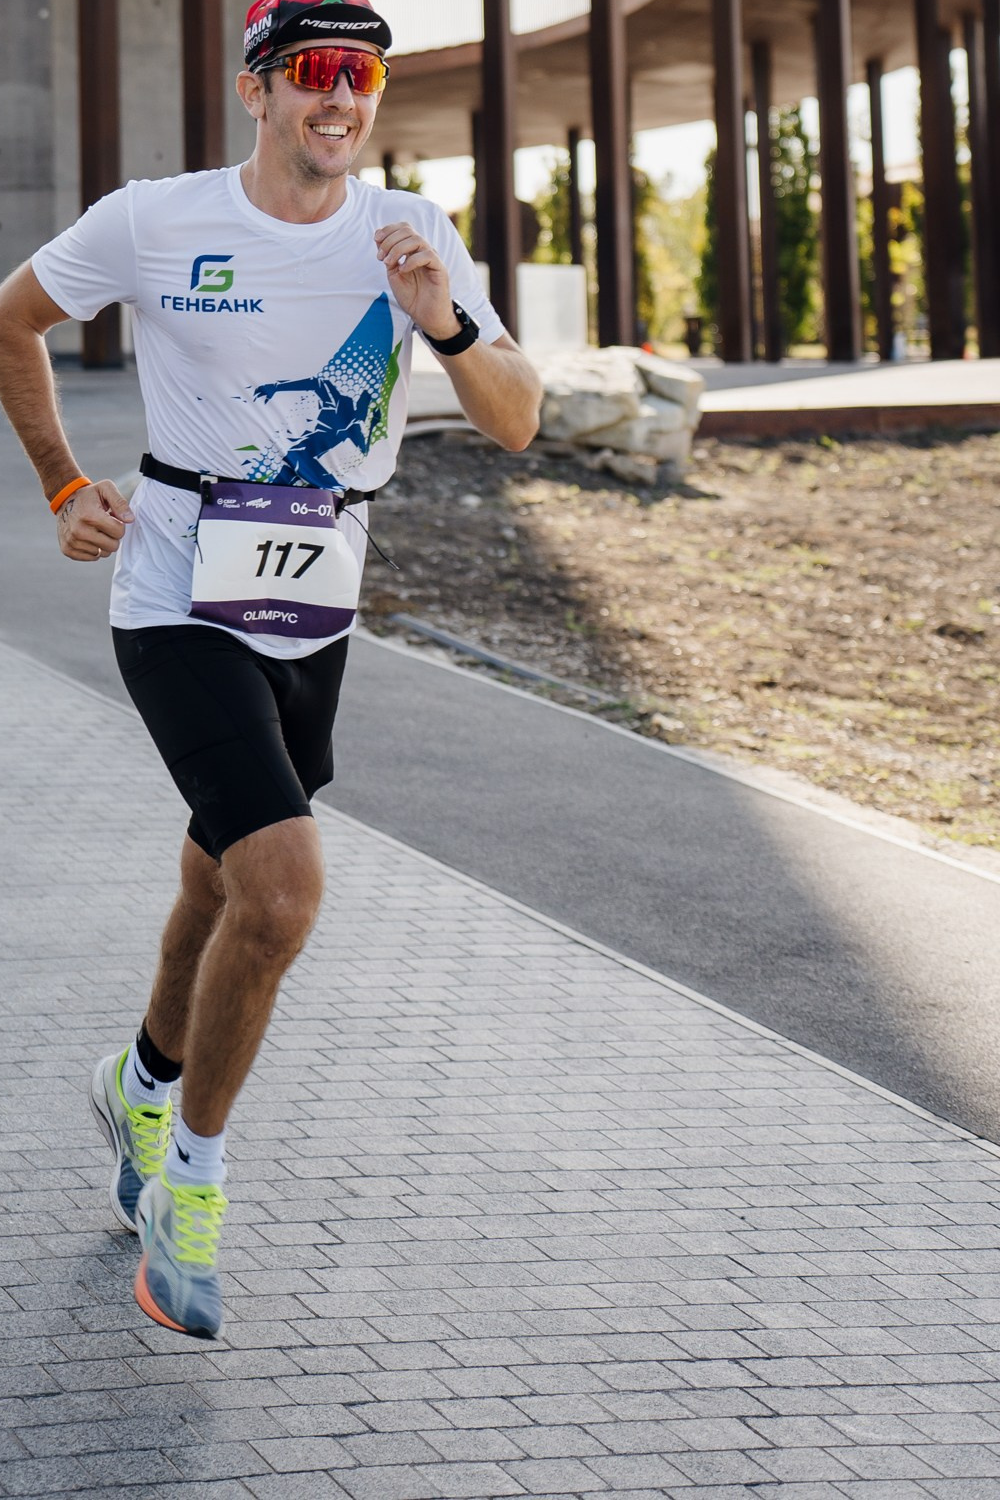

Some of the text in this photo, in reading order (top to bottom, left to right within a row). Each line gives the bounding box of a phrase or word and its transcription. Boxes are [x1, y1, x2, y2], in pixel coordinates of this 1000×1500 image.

[300, 18, 381, 30] MERIDA
[161, 295, 264, 313] ГЕНБАНК
[256, 540, 325, 579] 117
[243, 610, 299, 624] OLIMPYC
